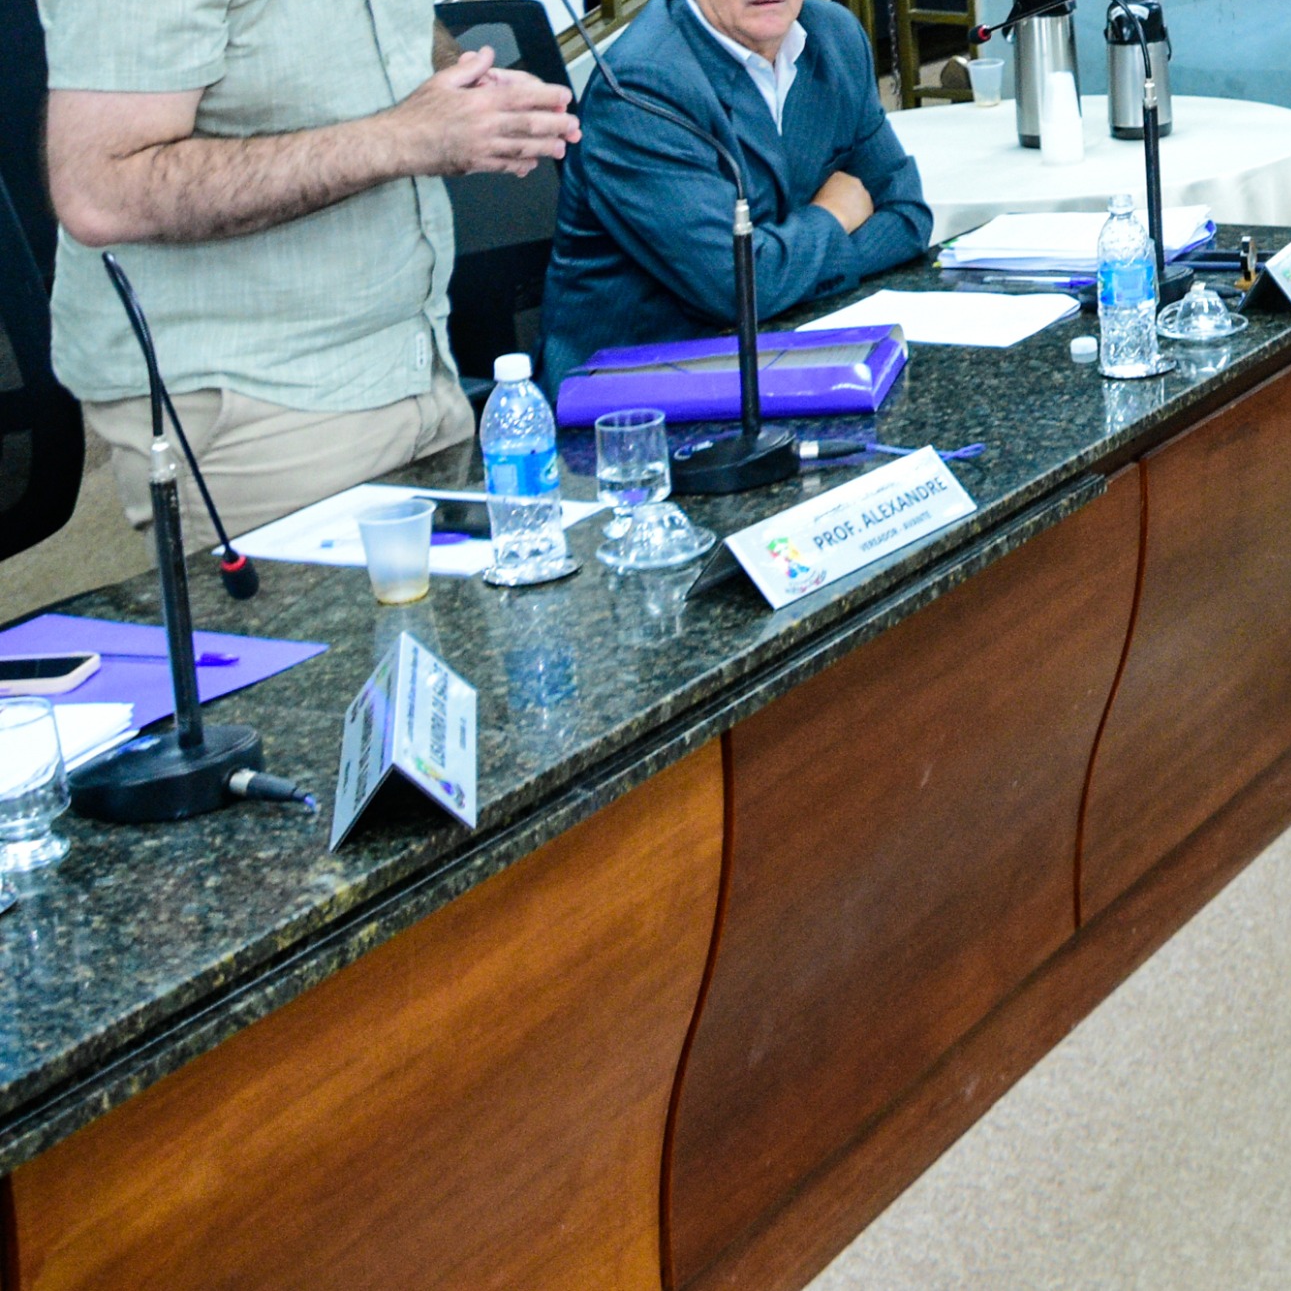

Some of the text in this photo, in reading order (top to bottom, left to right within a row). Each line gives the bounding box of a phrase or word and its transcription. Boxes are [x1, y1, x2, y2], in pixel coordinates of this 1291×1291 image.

[813, 520, 863, 550] PROF.
[860, 476, 948, 528] ALEXANDRE
[861, 527, 898, 551] VEREADOR
